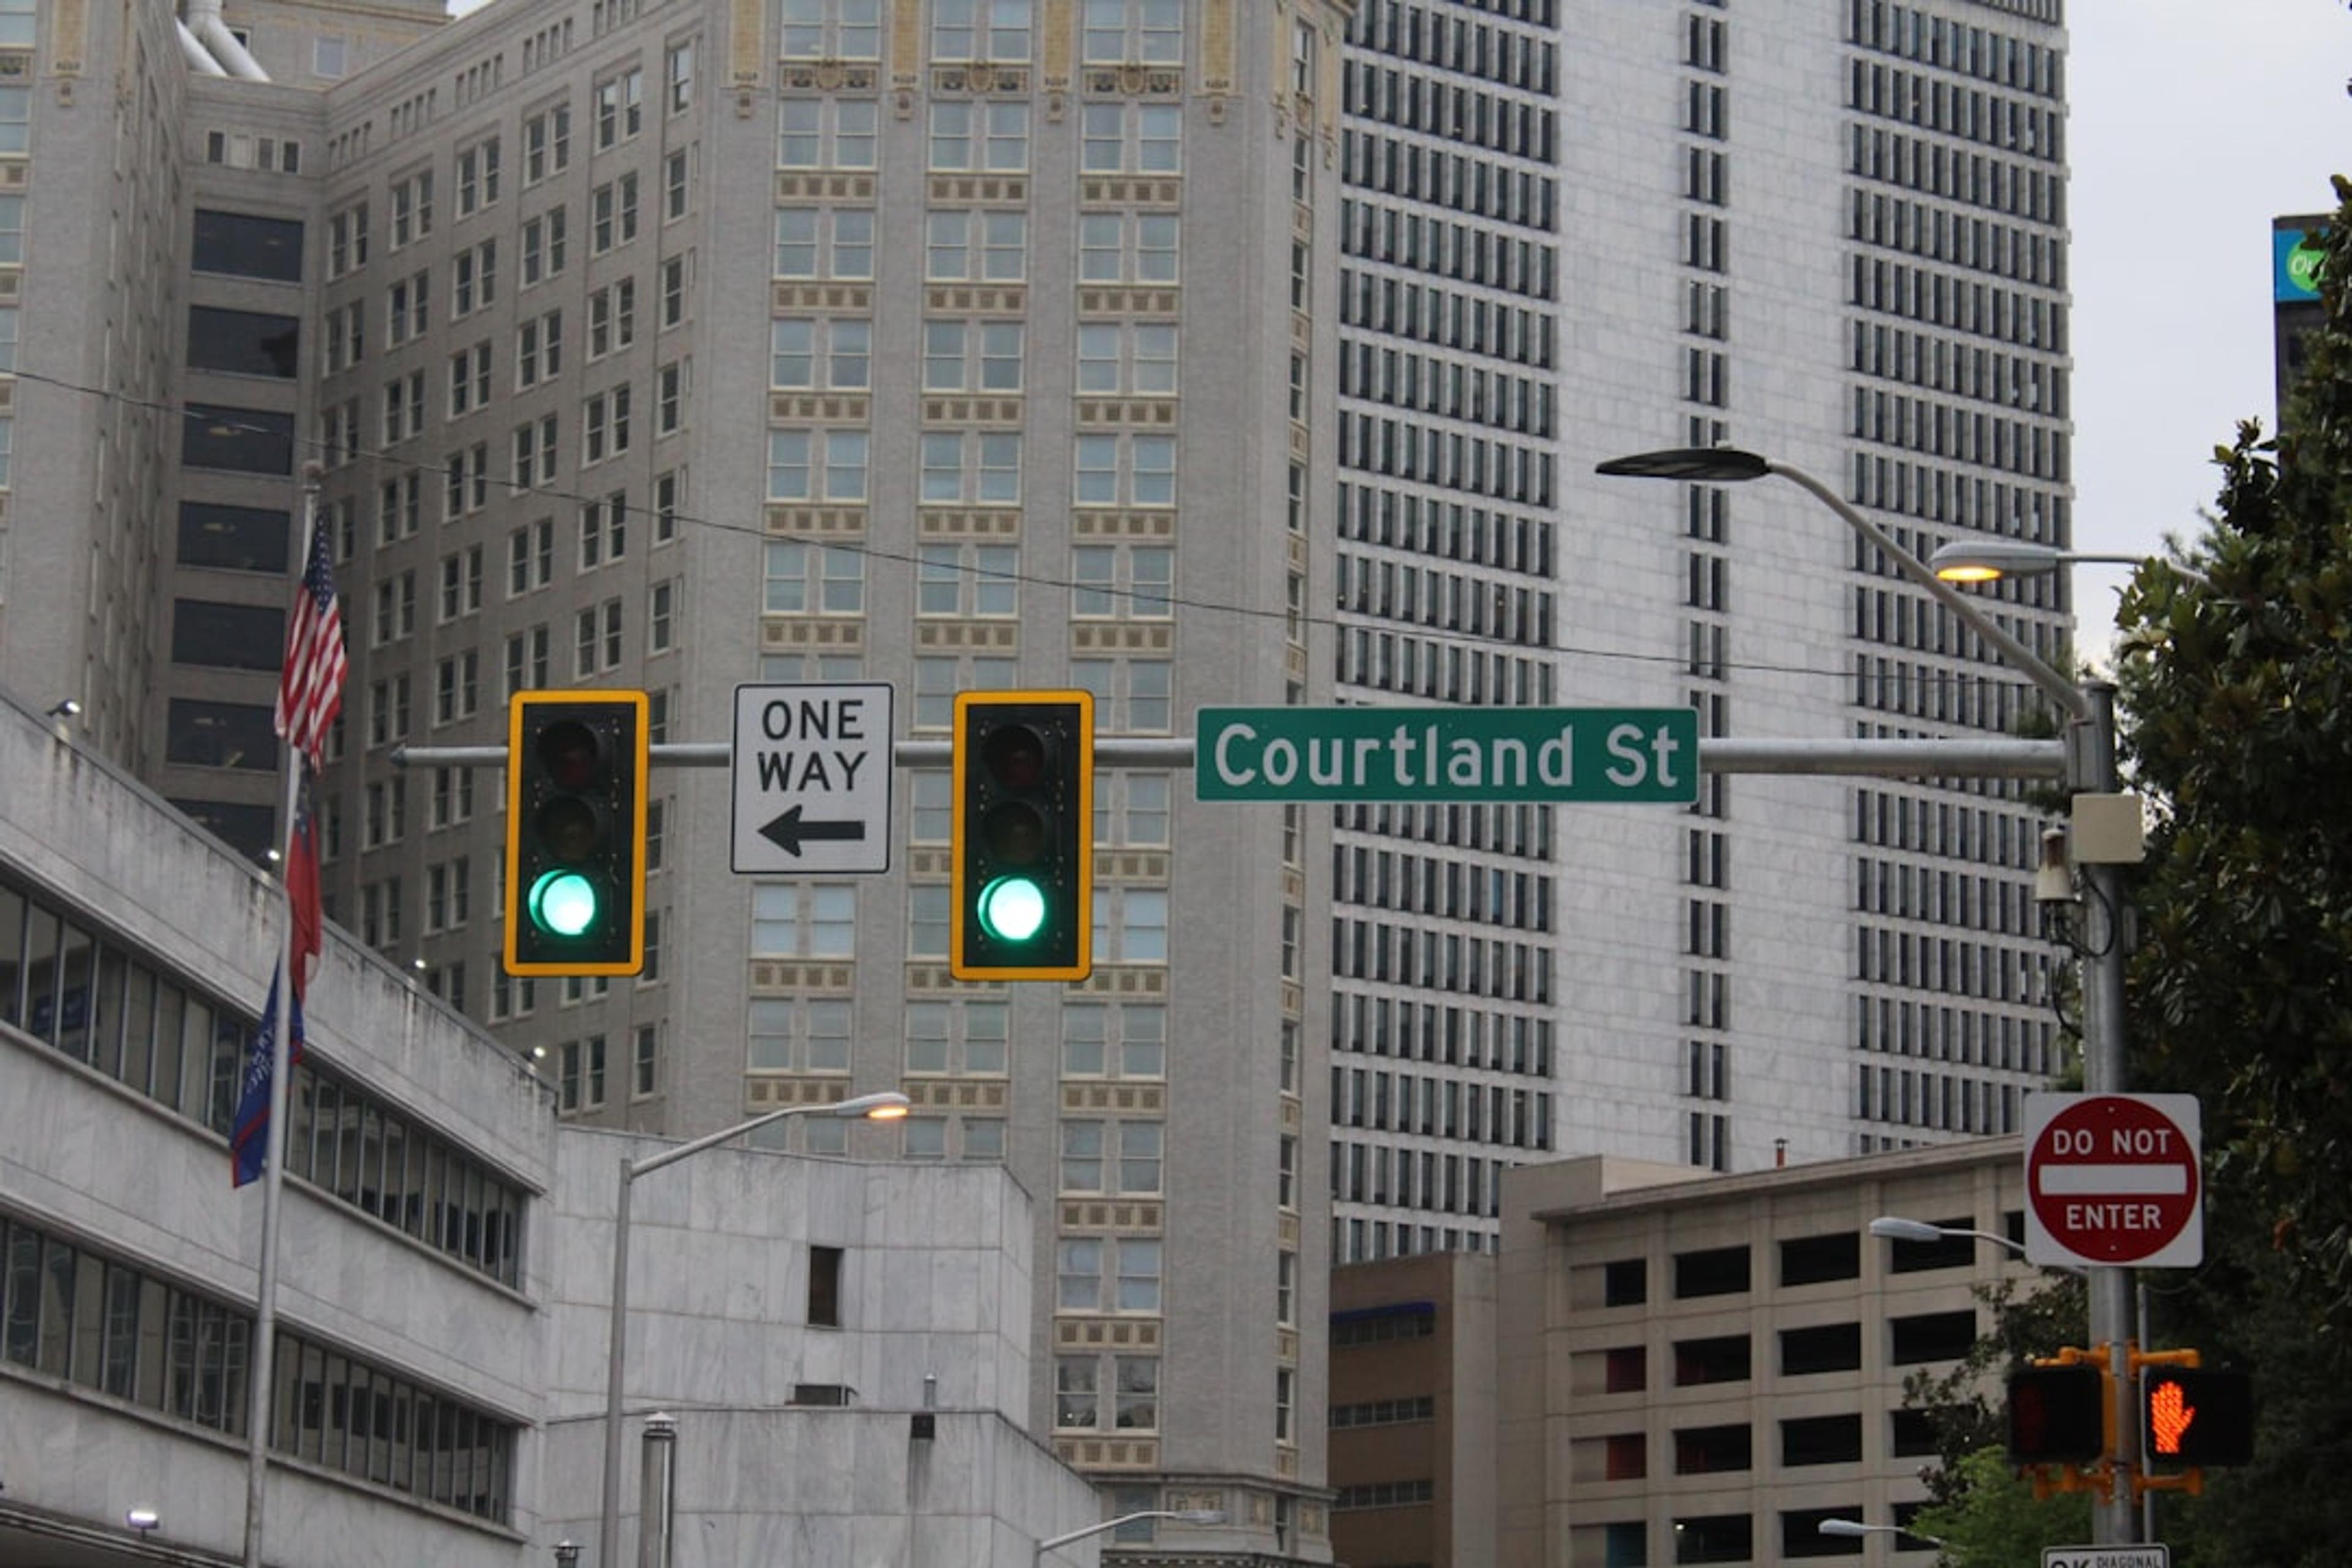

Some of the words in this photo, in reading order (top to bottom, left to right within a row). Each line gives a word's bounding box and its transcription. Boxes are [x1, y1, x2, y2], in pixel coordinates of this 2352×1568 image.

[762, 699, 864, 740] ONE
[757, 751, 868, 791] WAY
[1215, 723, 1573, 786] Courtland
[1605, 723, 1679, 787] St
[2052, 1129, 2094, 1155] DO
[2112, 1129, 2171, 1155] NOT
[2066, 1204, 2162, 1230] ENTER
